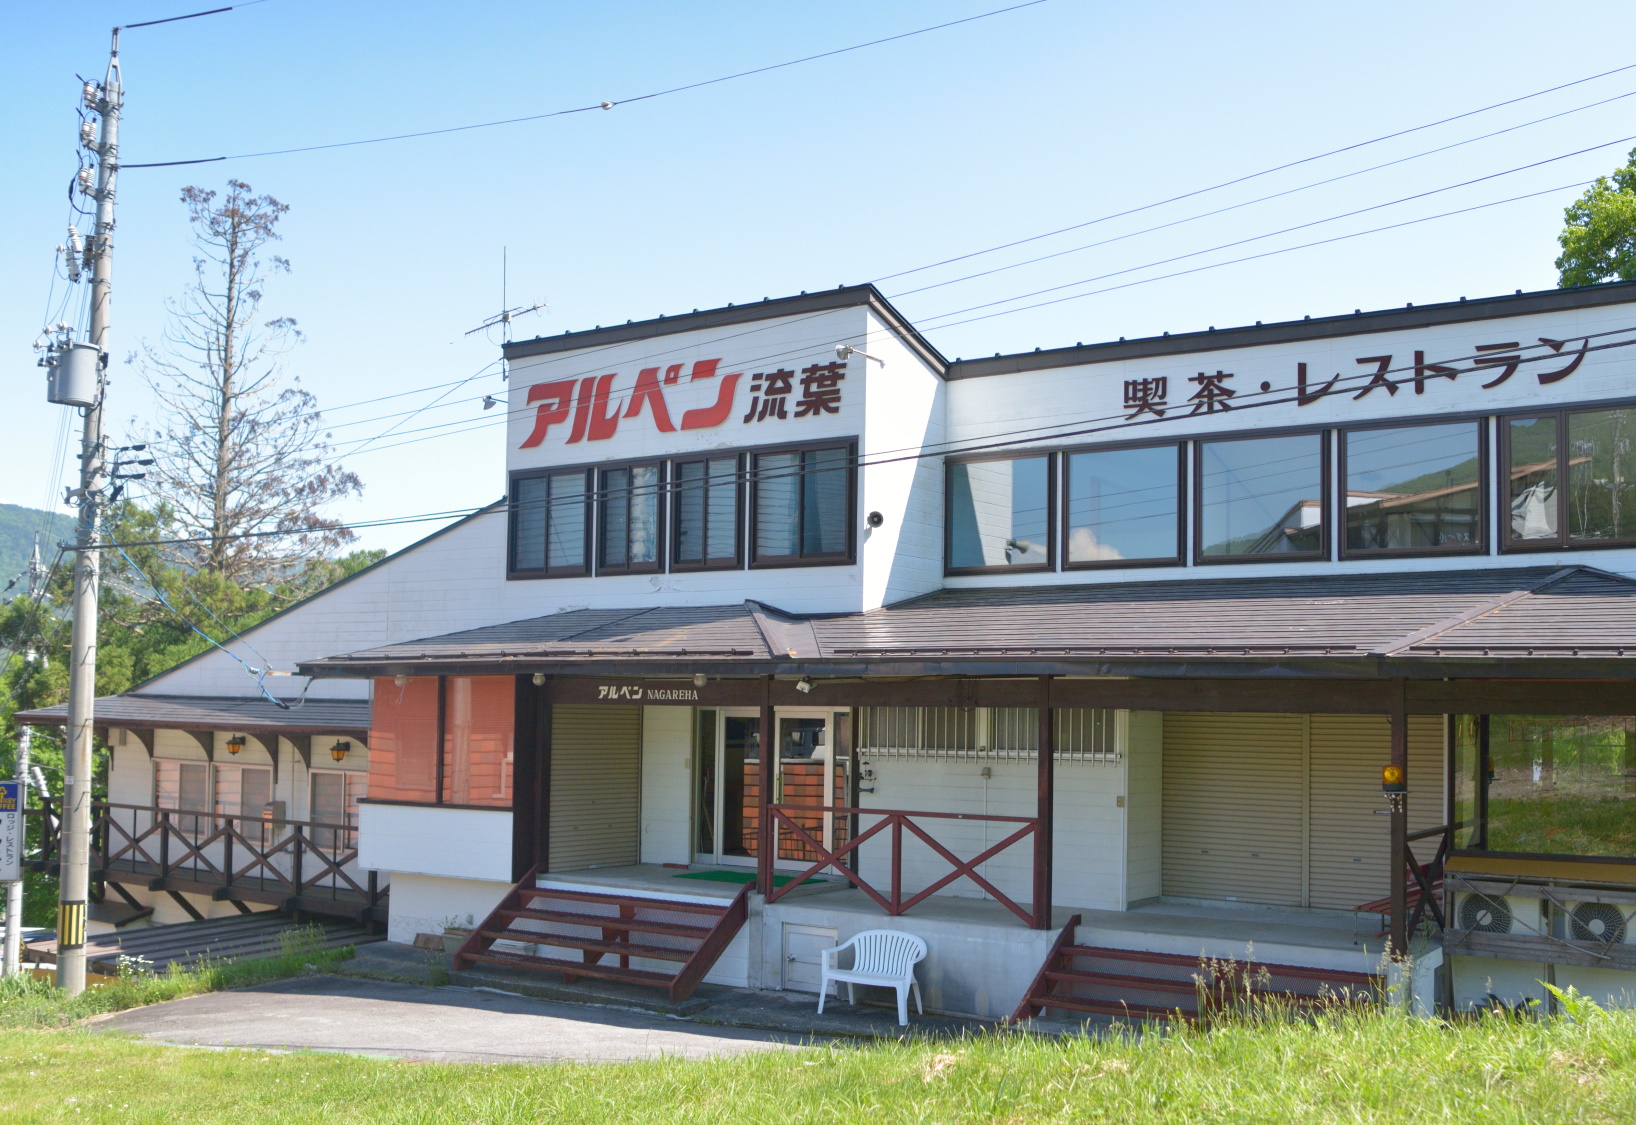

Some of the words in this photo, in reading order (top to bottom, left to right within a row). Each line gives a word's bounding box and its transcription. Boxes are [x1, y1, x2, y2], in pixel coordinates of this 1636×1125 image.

[518, 358, 744, 449] アルペン
[743, 361, 847, 424] 流葉
[1123, 337, 1589, 421] 喫茶・レストラン
[598, 686, 643, 699] アルペン
[647, 689, 699, 700] NAGAREHA
